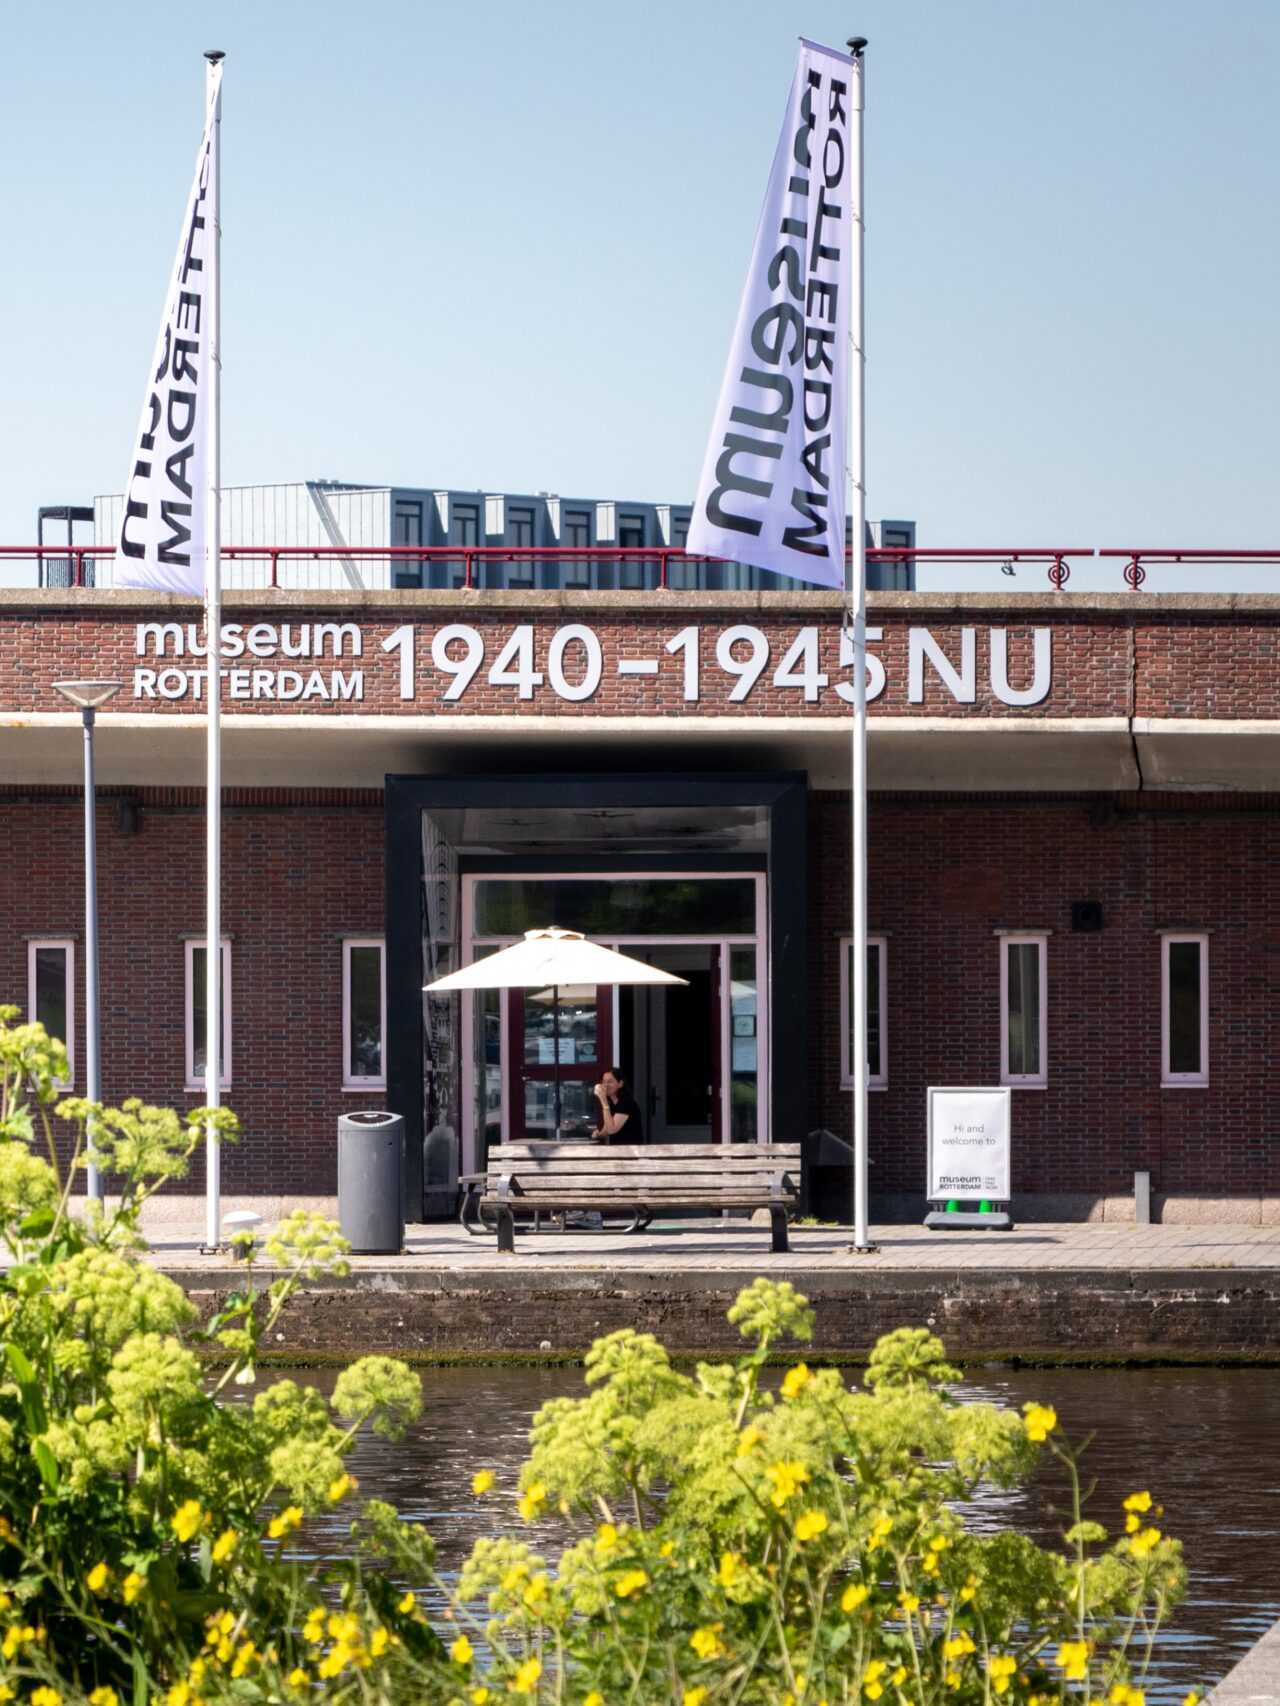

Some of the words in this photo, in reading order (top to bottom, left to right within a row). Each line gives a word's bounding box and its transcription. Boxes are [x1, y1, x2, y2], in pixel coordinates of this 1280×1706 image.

[136, 622, 362, 657] museum
[908, 627, 1052, 706] NU
[954, 1124, 964, 1133] Hi
[967, 1124, 985, 1133] and
[942, 1136, 984, 1146] welcome
[986, 1137, 996, 1146] to
